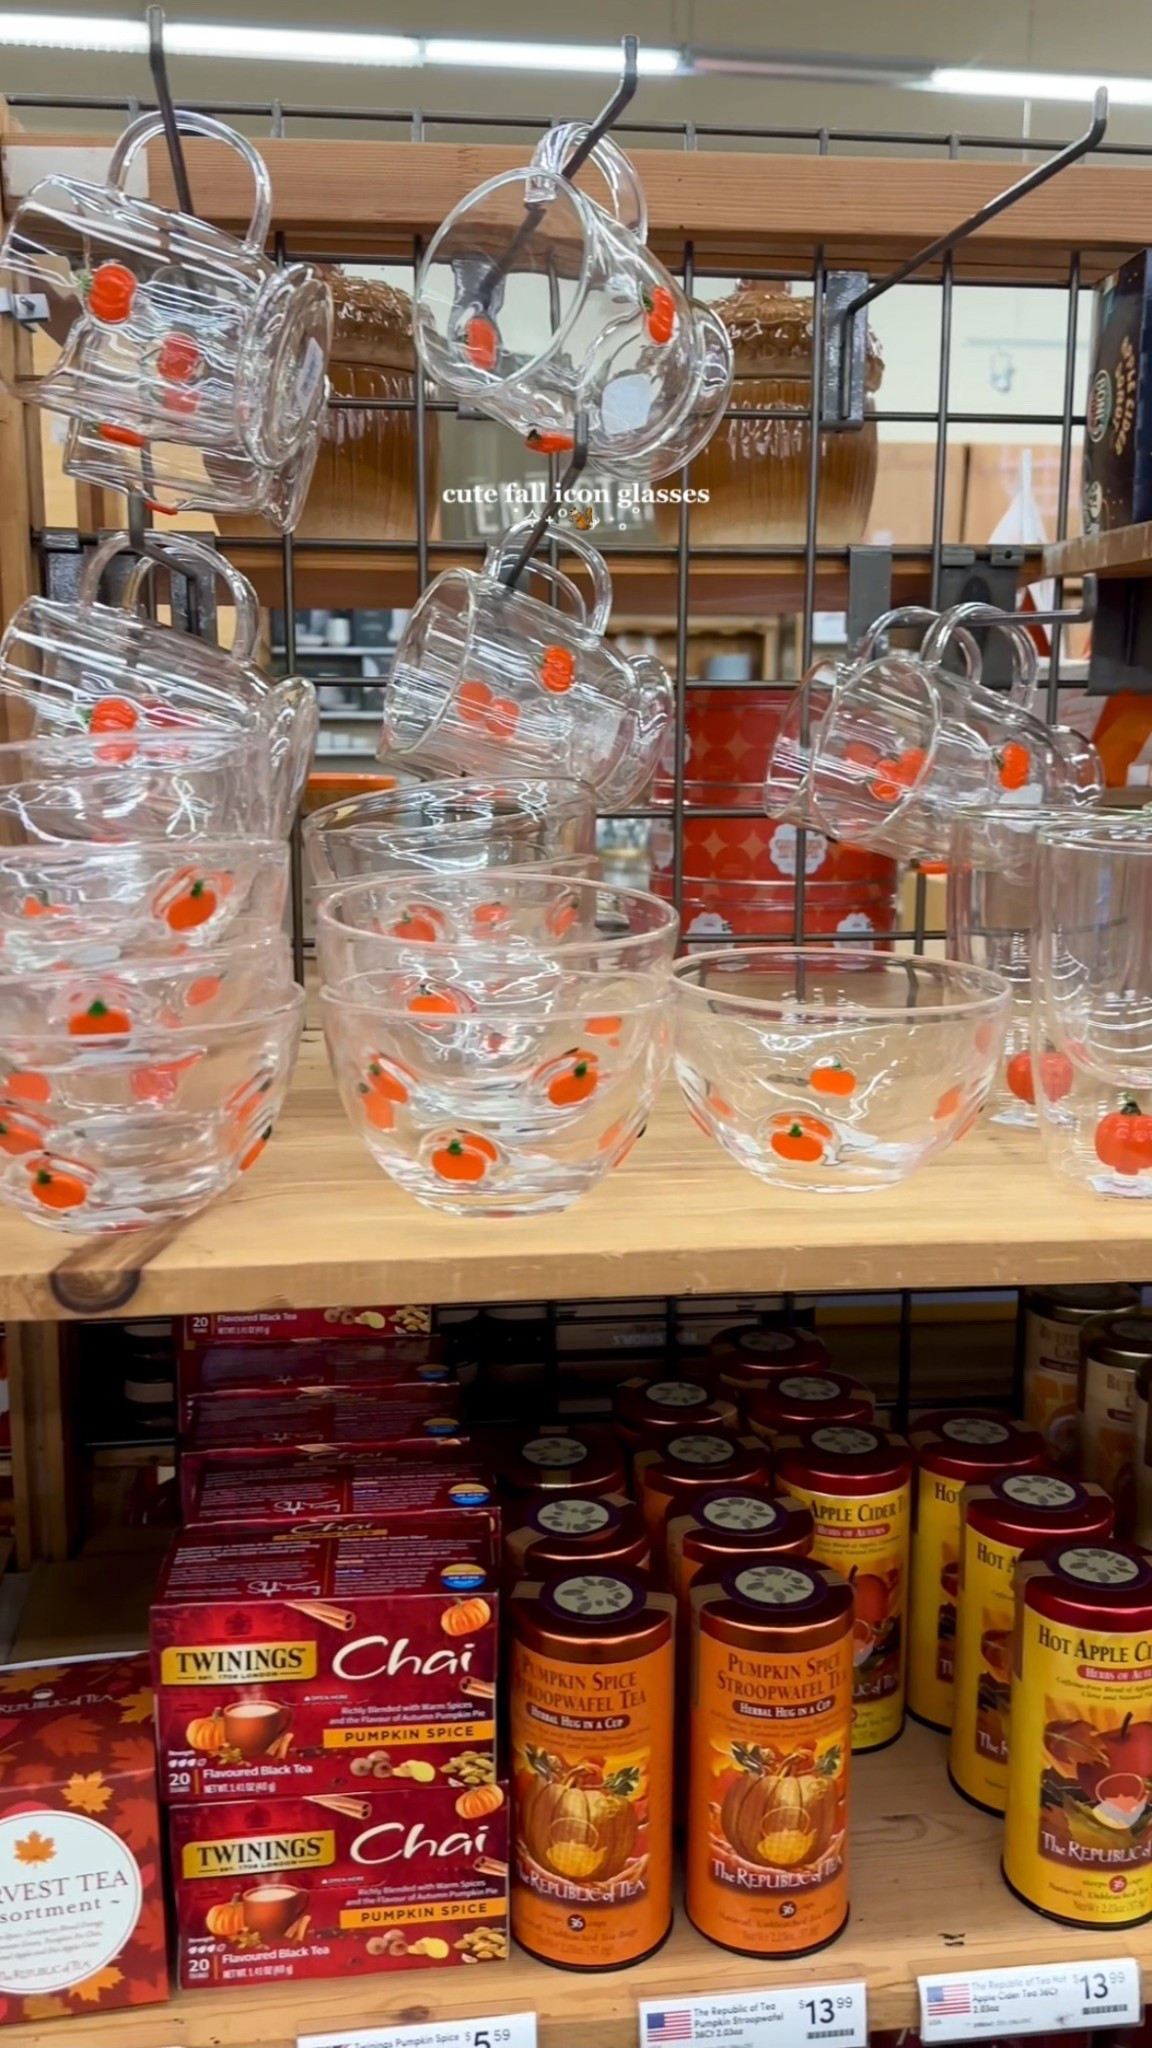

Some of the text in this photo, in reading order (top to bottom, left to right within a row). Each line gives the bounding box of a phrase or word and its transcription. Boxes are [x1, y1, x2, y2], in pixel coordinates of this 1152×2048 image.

[192, 1316, 209, 1328] 20
[259, 1312, 281, 1322] Black
[283, 1311, 297, 1321] Tea
[811, 1499, 852, 1522] APPLE
[857, 1502, 897, 1522] CIDER
[976, 1541, 1004, 1571] HOT
[1037, 1623, 1130, 1663] HOT APPLE
[176, 1647, 303, 1673] TWININGS
[332, 1635, 476, 1681] Chai
[727, 1652, 802, 1681] PUMPKIN
[592, 1671, 637, 1692] SPICE
[716, 1669, 825, 1701] STROOPWAFEL
[367, 1702, 401, 1714] Blended
[401, 1701, 420, 1712] with
[421, 1701, 446, 1711] Warm
[446, 1699, 473, 1712] Spices
[619, 1689, 647, 1710] TEA
[739, 1698, 833, 1719] HERBAL HUG IN A CUP
[329, 1708, 486, 1725] and the Flavour of Autumn Pumpkin Pie
[561, 1715, 581, 1729] HUG
[583, 1720, 594, 1730] IN
[595, 1721, 603, 1730] A
[605, 1717, 625, 1729] CUP
[344, 1725, 475, 1743] PUMPKIN SPICE
[168, 1773, 191, 1786] 20
[203, 1763, 313, 1779] Flavoured Black Tea
[196, 1837, 322, 1867] TWININGS
[350, 1822, 490, 1865] Chai
[1041, 1830, 1066, 1856] The
[1068, 1840, 1142, 1863] REPUBLIC
[75, 1869, 129, 1893] TEA
[711, 1855, 844, 1889] The REPUBLIC of TEA
[384, 1885, 417, 1897] Blended
[417, 1884, 436, 1894] with
[460, 1879, 487, 1892] Spices
[530, 1870, 602, 1901] REPUBLIC
[602, 1885, 615, 1903] of
[614, 1879, 646, 1898] TEA
[345, 1887, 498, 1907] and the Flavour of Autumn Pumpkin Pie
[361, 1903, 488, 1923] PUMPKIN SPICE
[781, 1903, 795, 1917] 36
[570, 1917, 584, 1929] 36
[222, 1945, 330, 1964] Flavoured Black Tea
[188, 1959, 210, 1972] 20
[971, 1975, 1067, 1991] The Republic of Tea Hot
[1109, 1971, 1126, 1984] 99
[836, 1996, 853, 2009] 99
[972, 1993, 998, 2004] Apple
[999, 1990, 1020, 2001] Cider
[1022, 1989, 1037, 1999] Tea
[693, 2001, 776, 2017] The Republic of Tea
[694, 2012, 784, 2028] Pumpkin Stroopwafel
[394, 2034, 434, 2048] Pumpkin
[435, 2032, 460, 2044] Spice
[493, 2028, 511, 2042] 59
